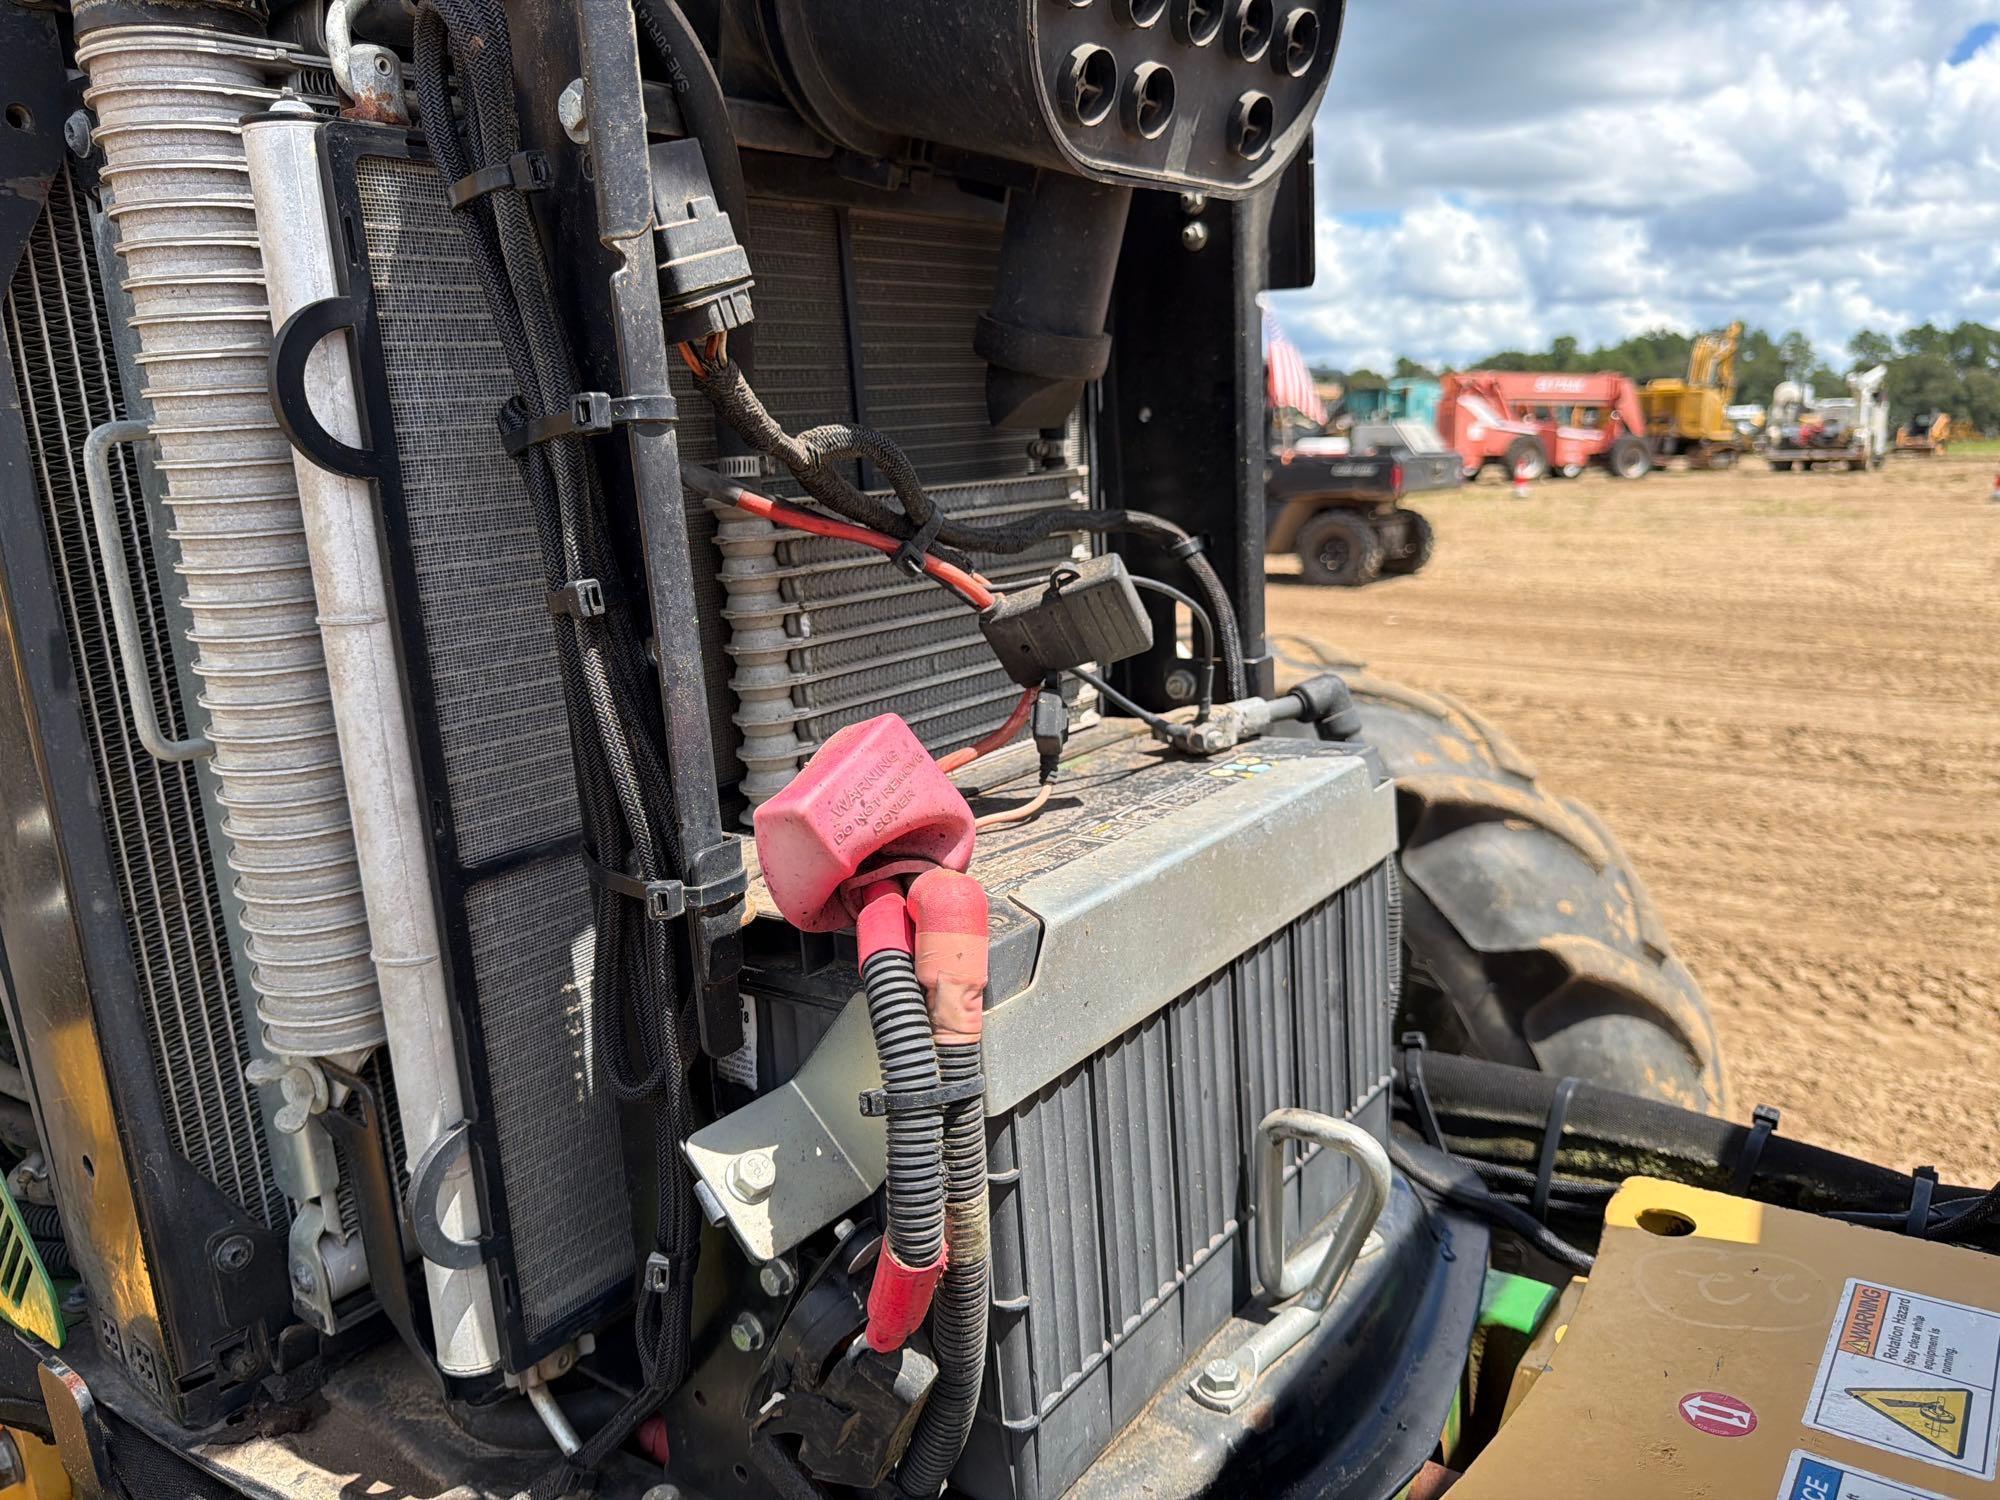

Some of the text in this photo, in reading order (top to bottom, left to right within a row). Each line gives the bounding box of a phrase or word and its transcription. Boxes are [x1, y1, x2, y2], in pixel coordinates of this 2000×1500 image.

[639, 8, 690, 93] SAE 30R14
[831, 750, 898, 817] WARNING
[833, 751, 925, 846] DO NOT REMOVE
[872, 788, 917, 836] COVER
[1848, 1288, 1882, 1342] WARNING
[1882, 1297, 1911, 1361] Rotation Hazard
[1903, 1315, 1926, 1366] Stay clear while
[1923, 1327, 1941, 1371] equipment is
[1942, 1347, 1958, 1375] running.
